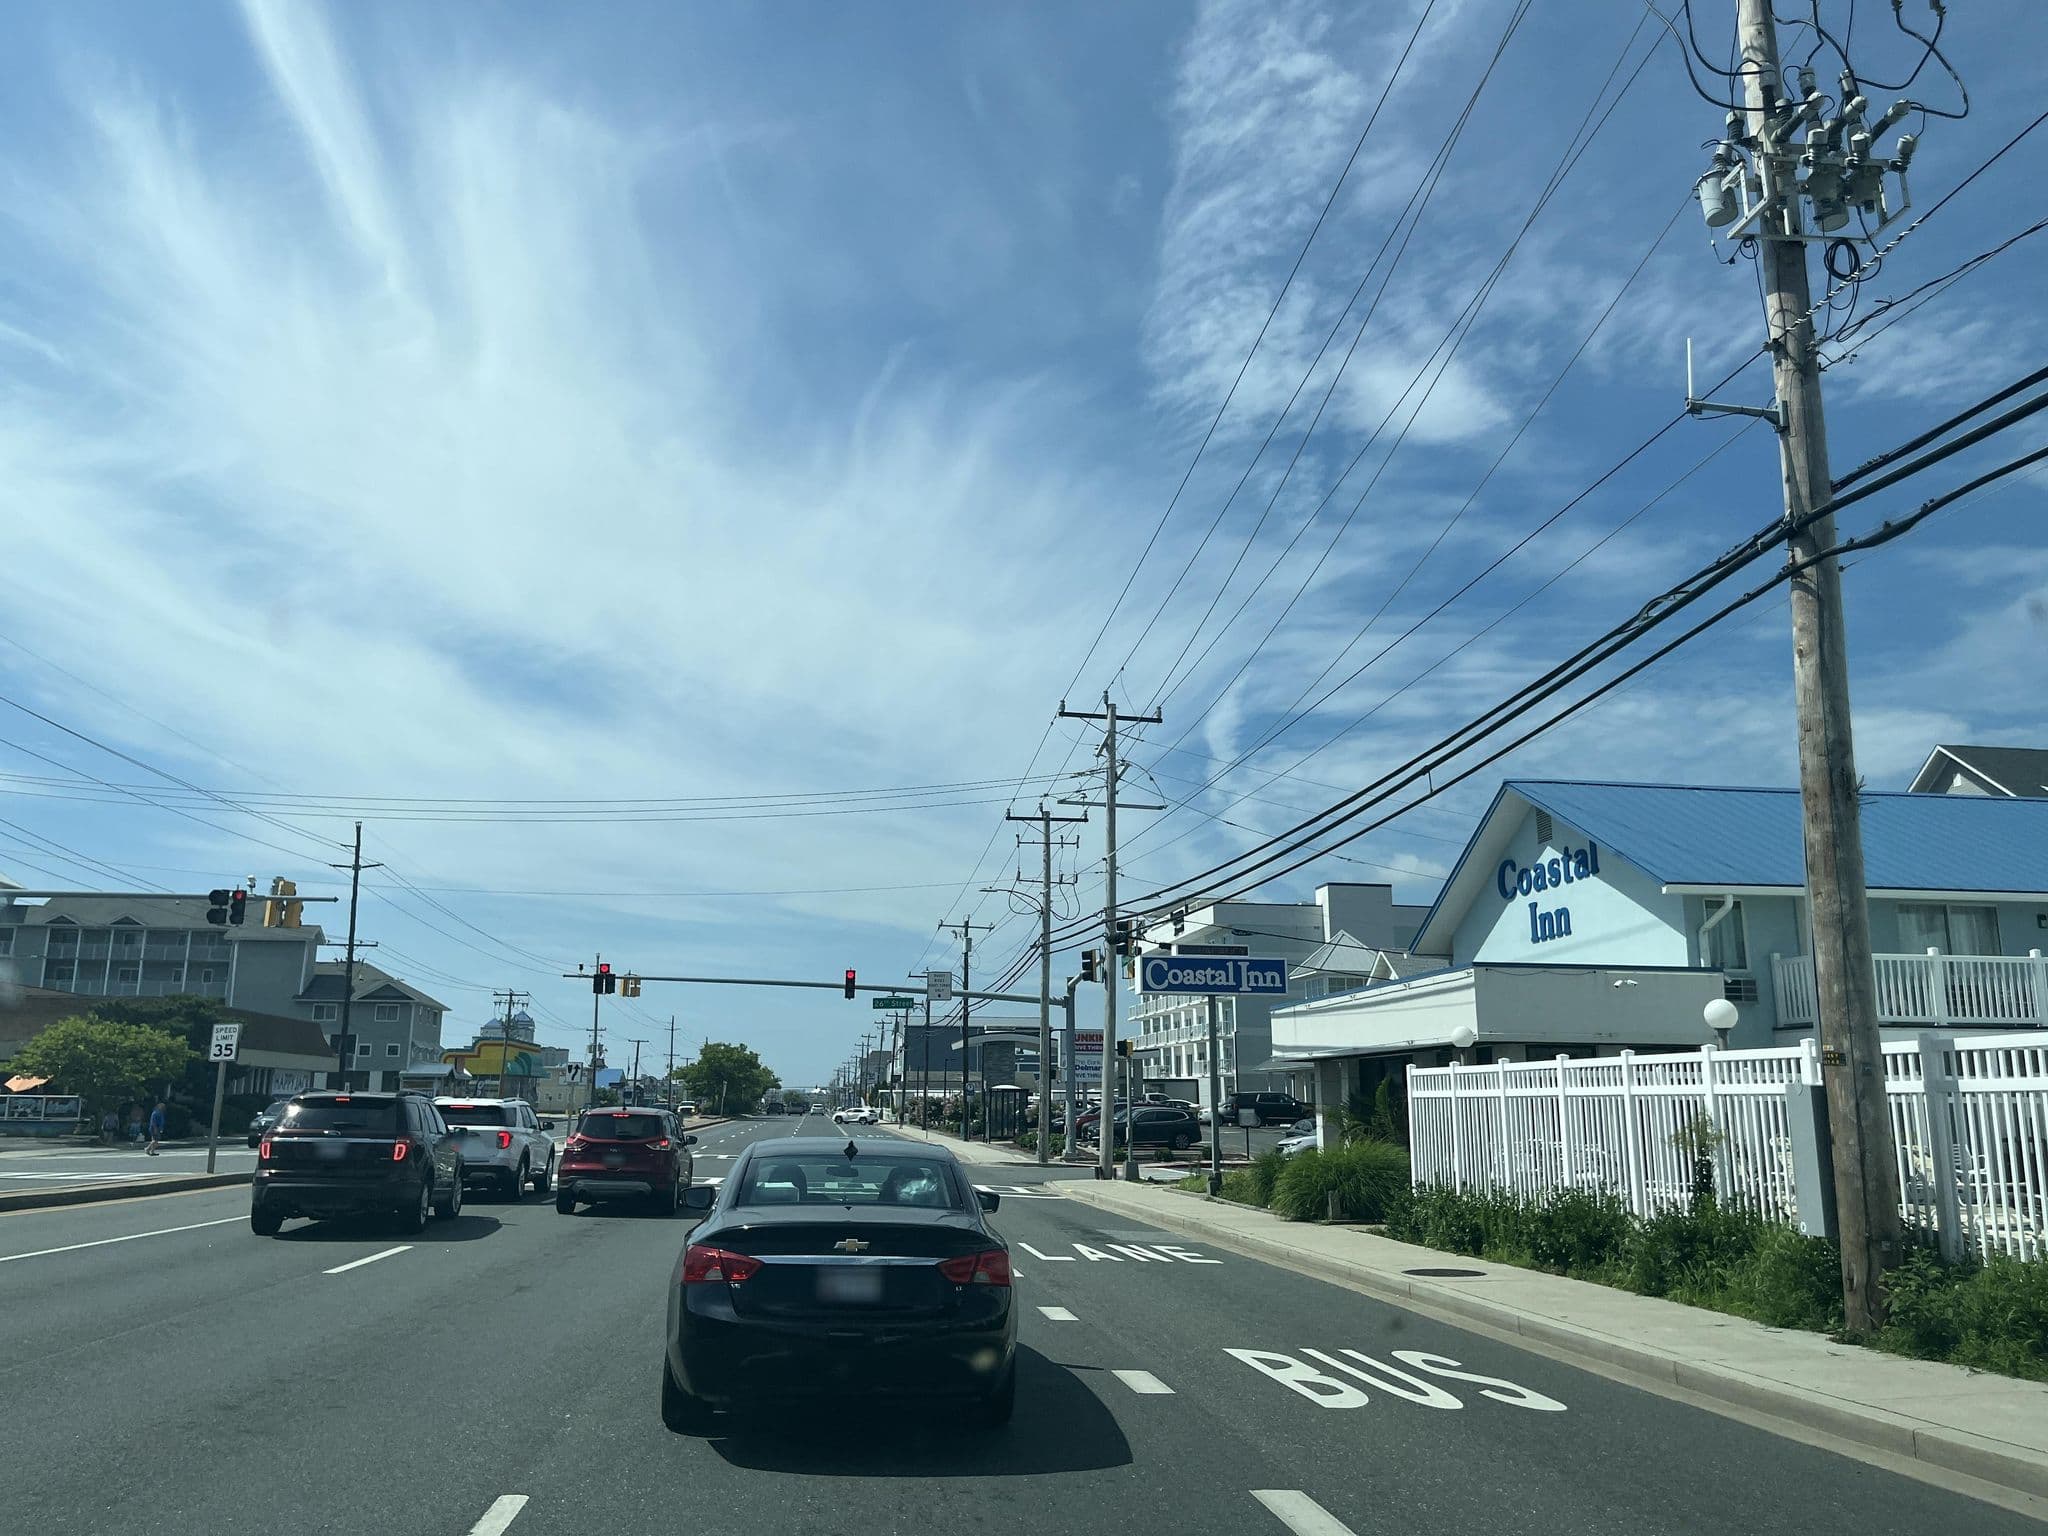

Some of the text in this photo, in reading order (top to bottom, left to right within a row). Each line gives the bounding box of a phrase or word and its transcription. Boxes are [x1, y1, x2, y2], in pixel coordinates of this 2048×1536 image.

[1497, 840, 1600, 900] Coastal
[1528, 901, 1572, 944] Inn
[1145, 959, 1282, 992] Coastal Inn
[213, 1043, 234, 1057] 35
[1075, 1033, 1104, 1042] UNKIN
[1017, 1242, 1224, 1264] LANE
[1222, 1347, 1568, 1411] BUS
